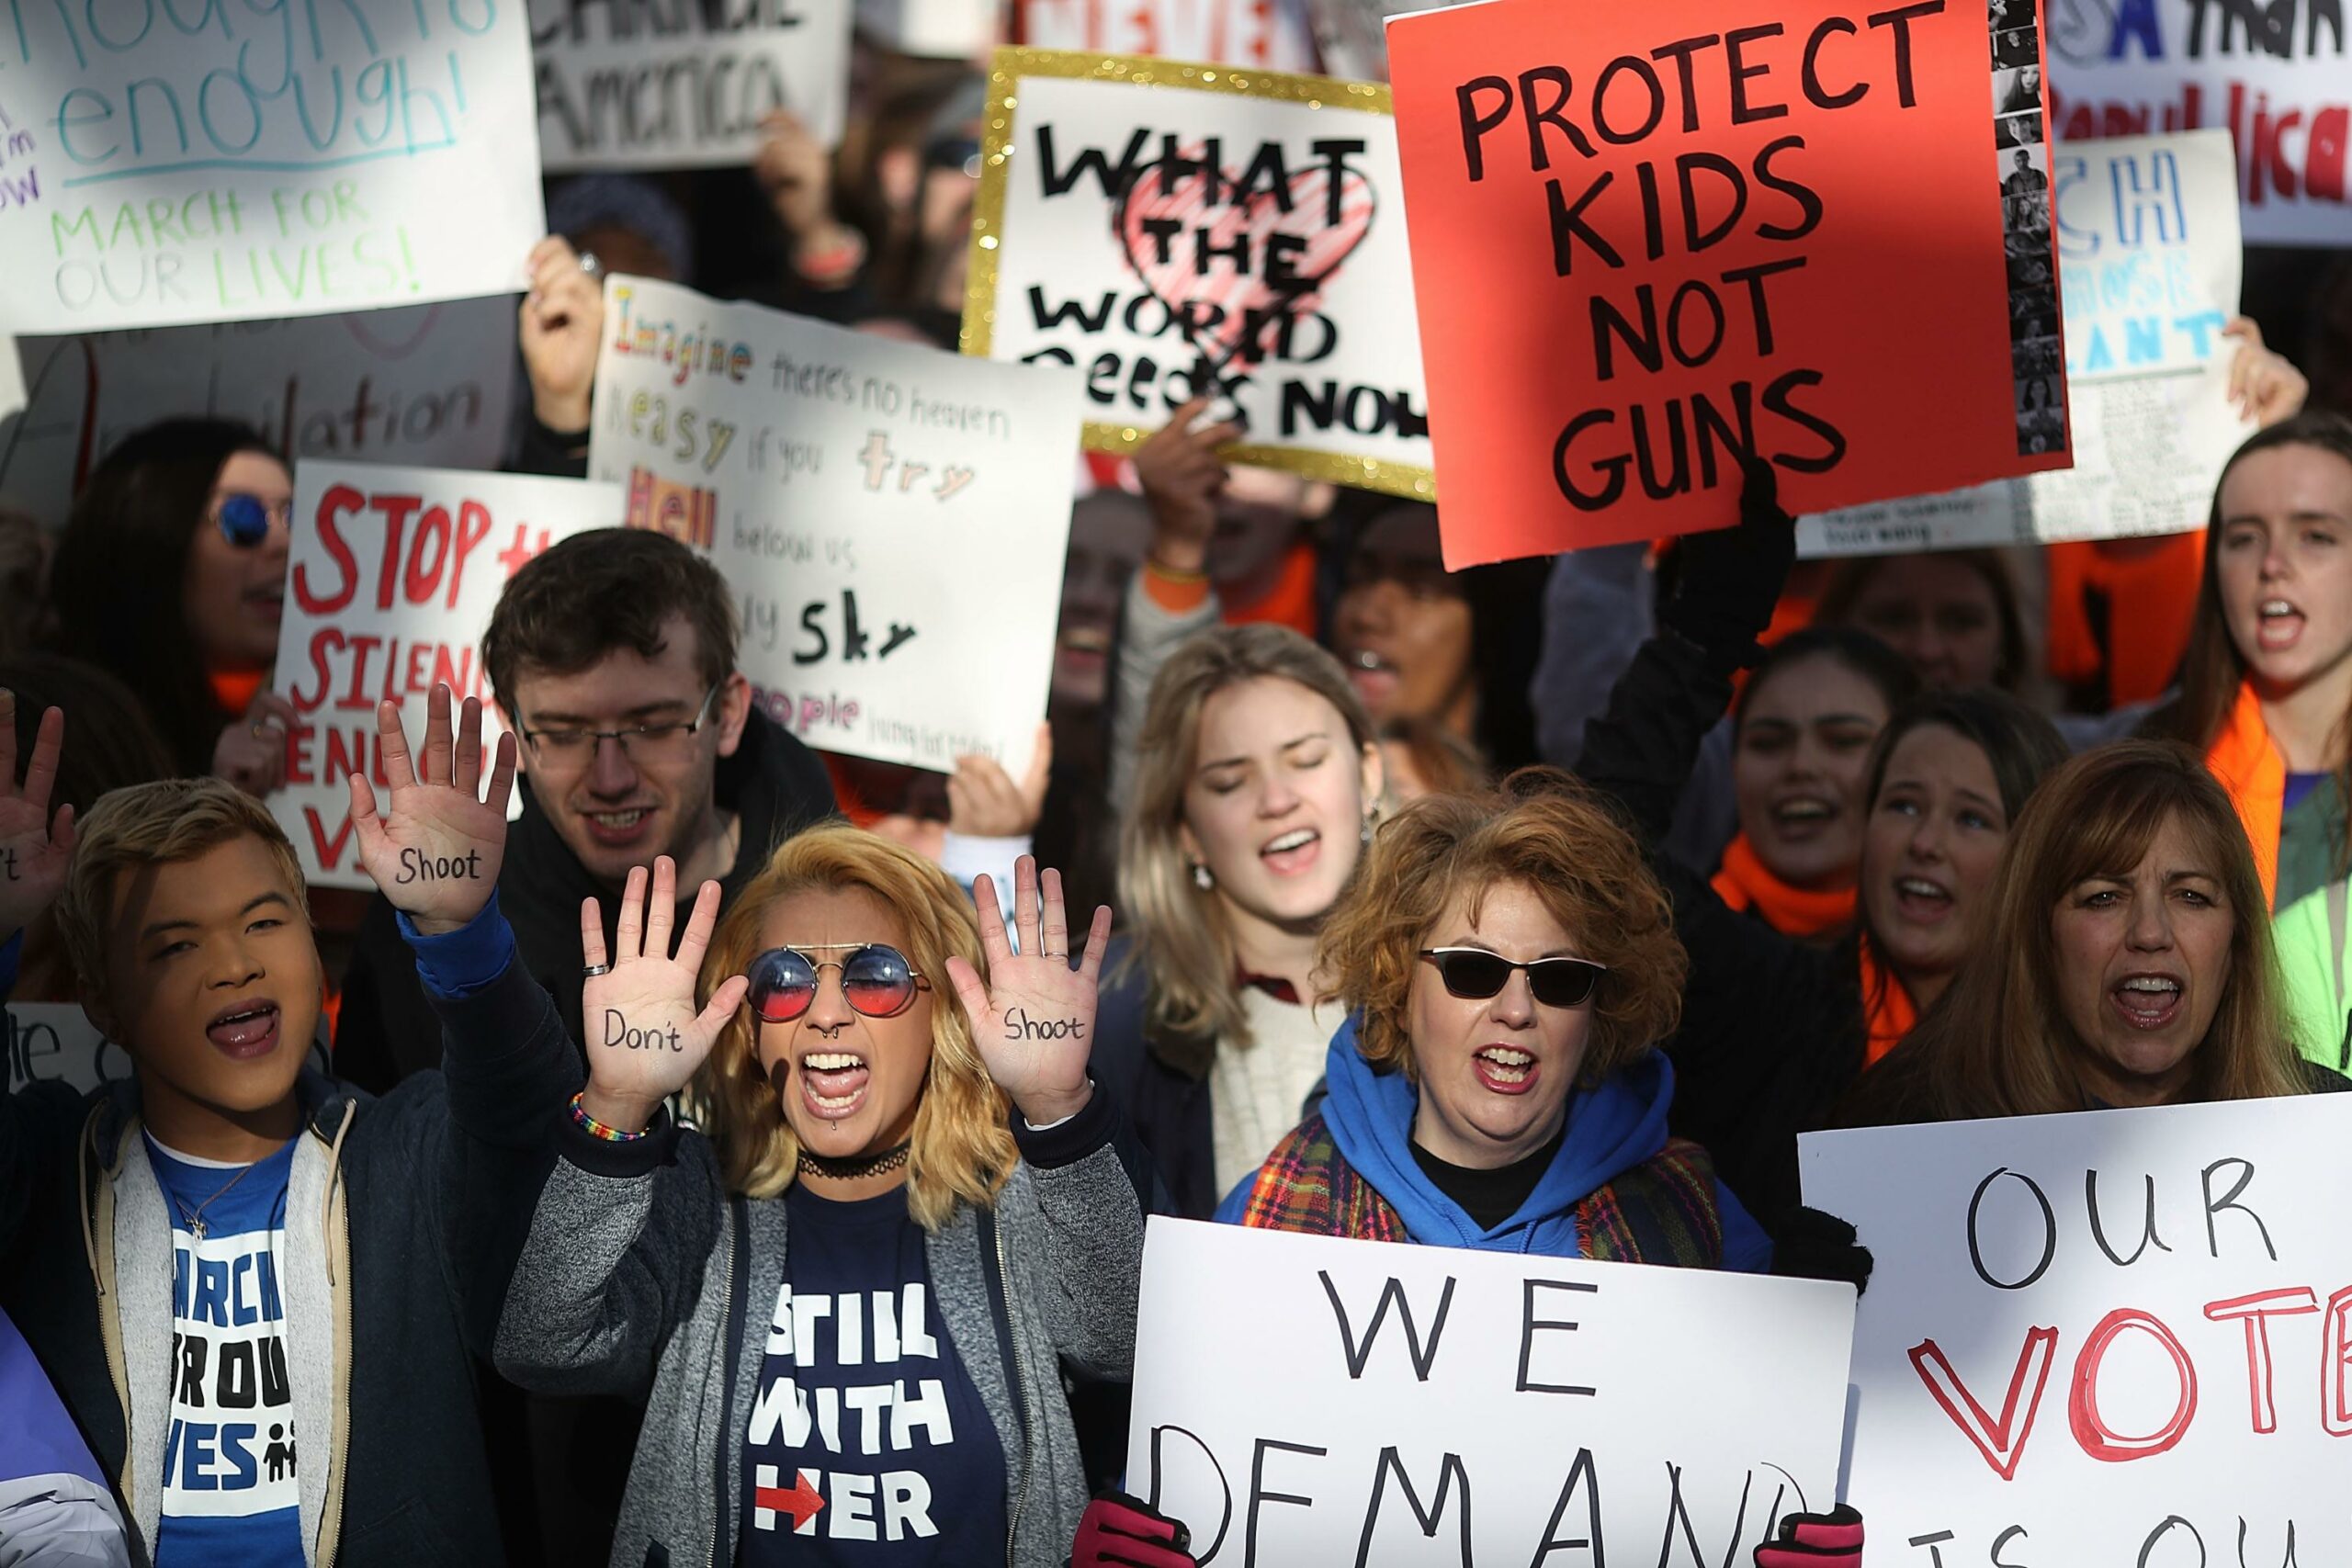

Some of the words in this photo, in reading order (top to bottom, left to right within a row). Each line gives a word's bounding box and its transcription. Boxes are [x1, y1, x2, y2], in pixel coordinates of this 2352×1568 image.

[47, 51, 467, 165] enough!
[528, 53, 787, 152] America
[1455, 3, 1945, 182] PROTECT
[51, 189, 244, 257] MARCH
[274, 178, 370, 239] FOR
[1035, 124, 1366, 228] WHAT
[1544, 135, 1824, 276] KIDS
[55, 254, 187, 311] OUR
[212, 225, 423, 309] LIVES!
[1143, 219, 1322, 292] THE
[616, 286, 752, 385] Imagine
[863, 377, 900, 414] no
[1027, 285, 1337, 364] WORLD
[1589, 256, 1808, 381] NOT
[2066, 310, 2226, 372] ANT
[628, 393, 735, 473] easy
[779, 443, 823, 485] you
[858, 429, 974, 502] try
[1553, 368, 1847, 512] GUNS
[293, 483, 492, 616] STOP
[751, 686, 861, 735] eople
[396, 847, 482, 884] Shoot
[603, 1009, 684, 1053] Don't
[1003, 1007, 1085, 1042] Shoot
[1967, 1156, 2278, 1290] OUR
[765, 1283, 938, 1367] STILL
[1318, 1269, 1598, 1396] WE
[748, 1376, 955, 1456] WITH
[754, 1463, 941, 1542] HER
